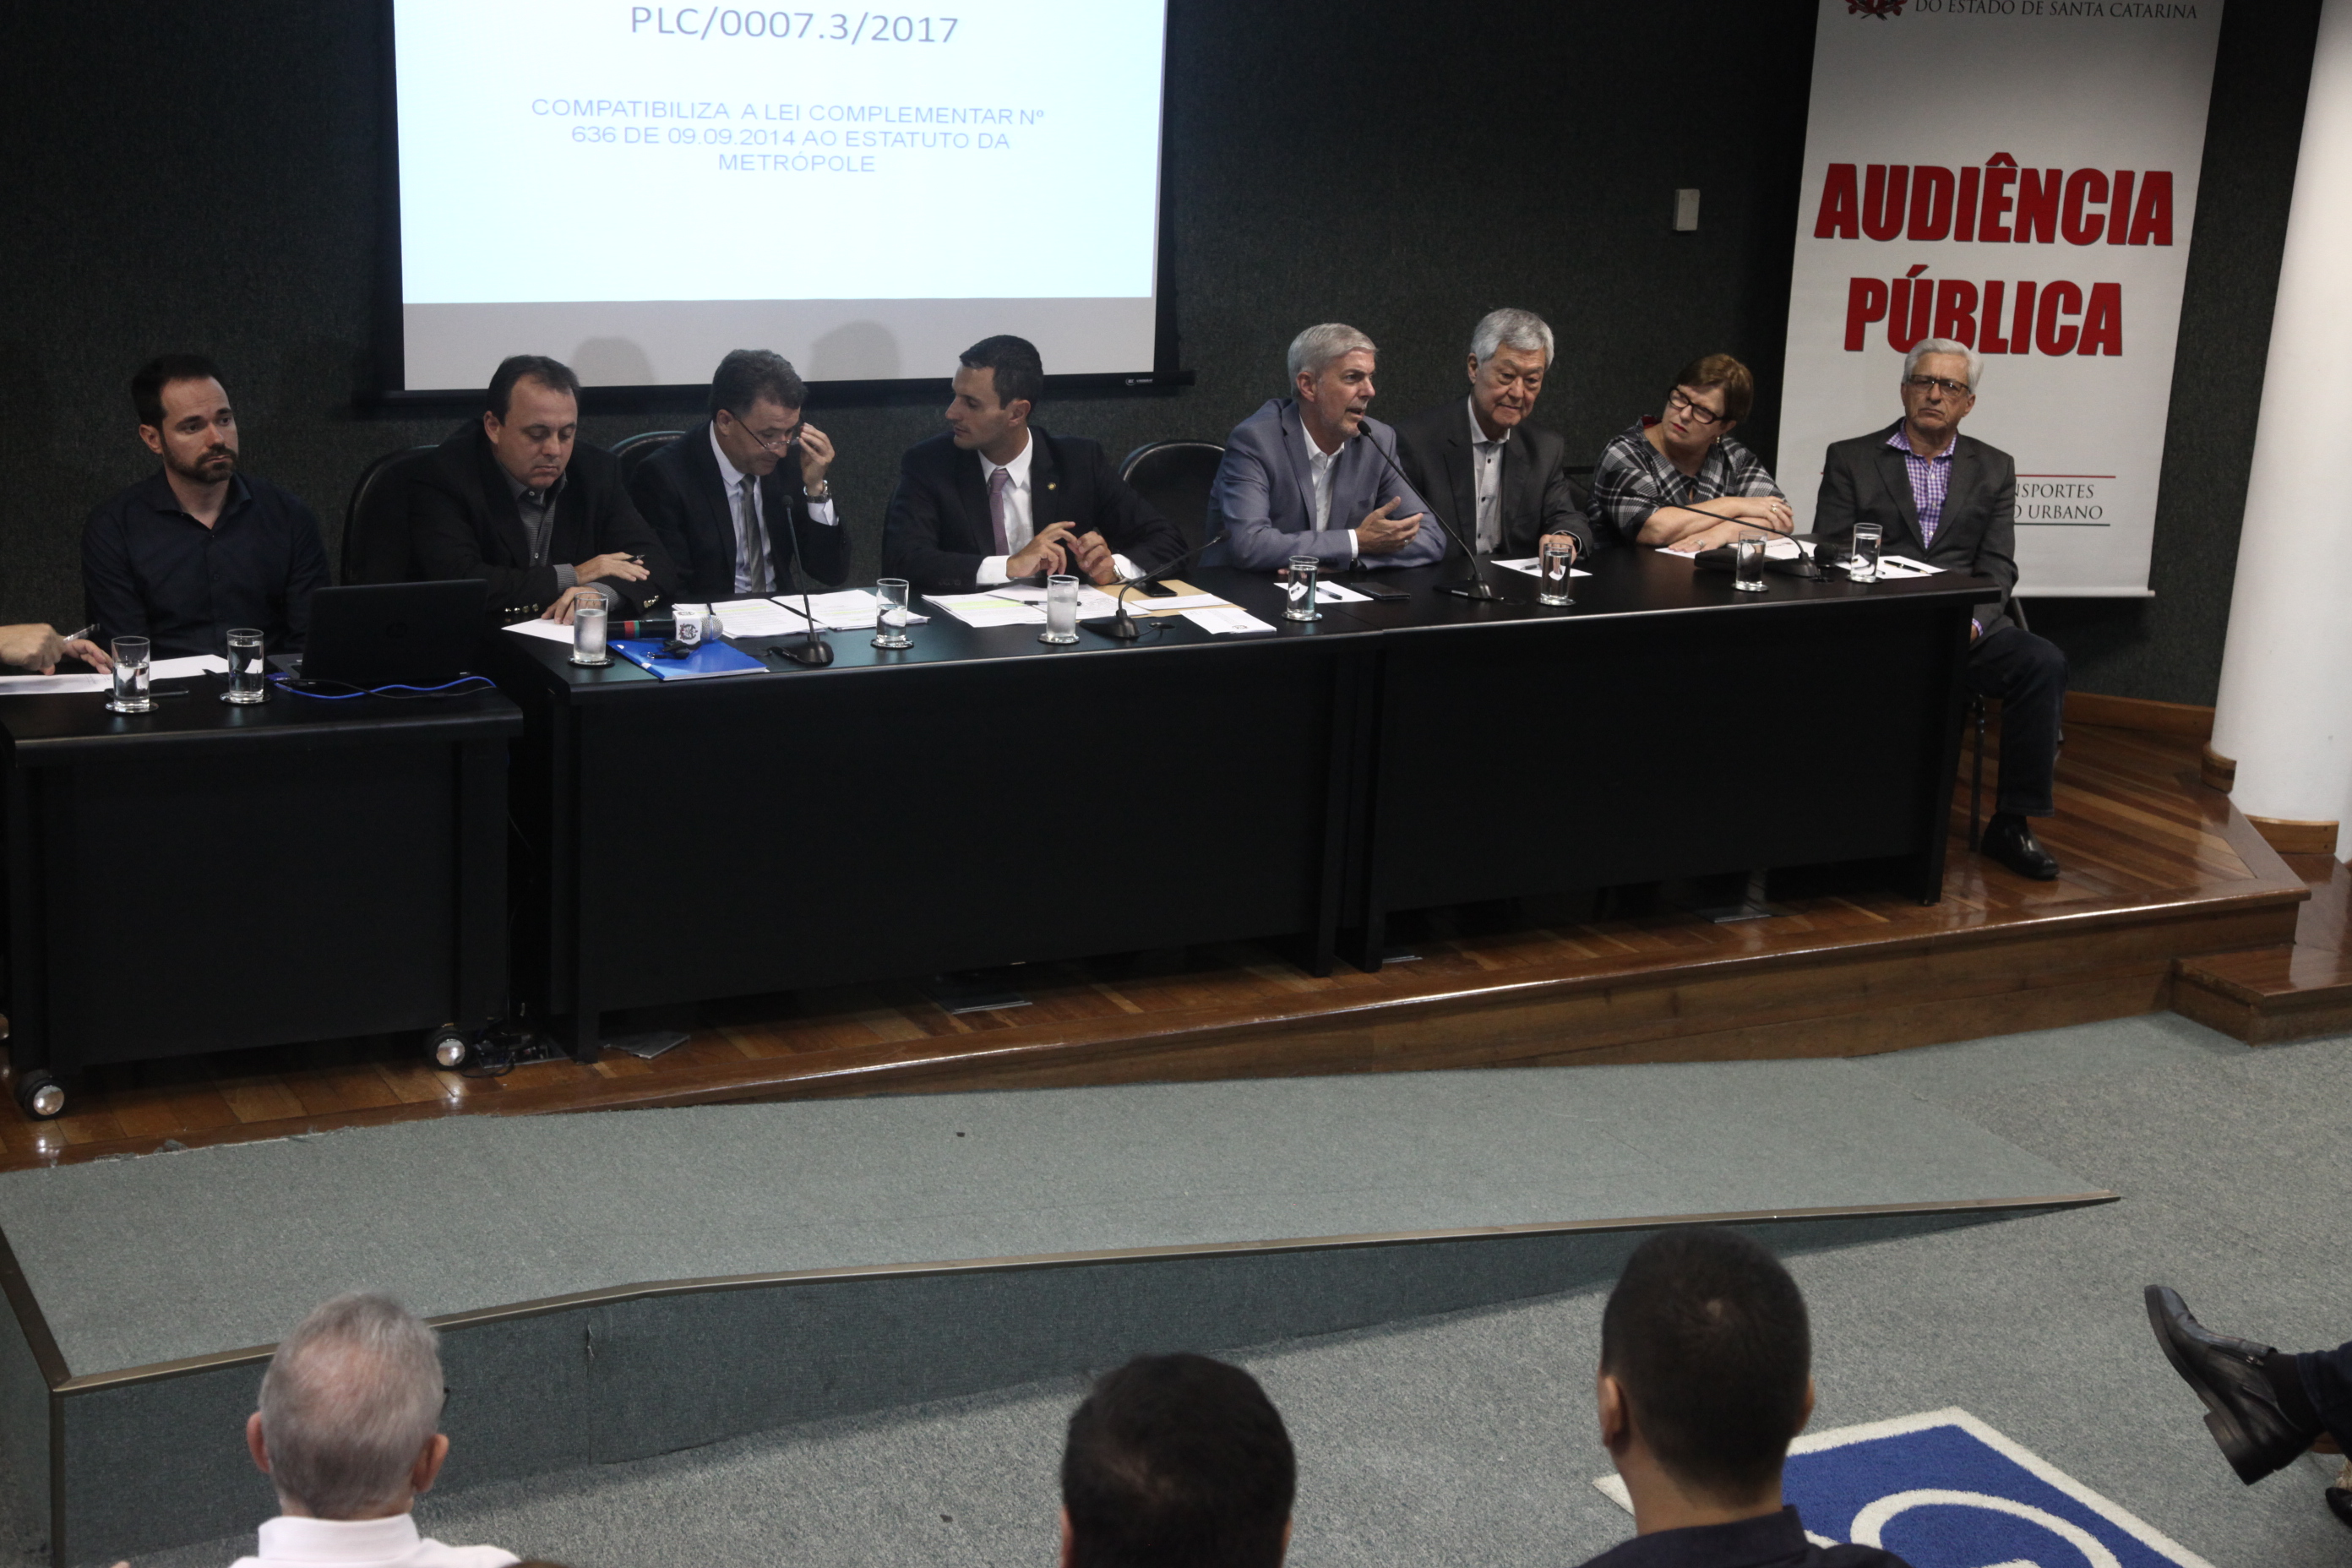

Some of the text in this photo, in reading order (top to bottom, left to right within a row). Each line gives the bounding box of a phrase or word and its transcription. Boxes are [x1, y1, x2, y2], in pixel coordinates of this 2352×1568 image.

[1914, 0, 1942, 13] DO
[1947, 0, 2015, 14] ESTADO
[2021, 0, 2044, 15] DE
[2049, 1, 2104, 17] SANTA
[2110, 3, 2197, 19] CATARINA
[631, 6, 958, 45] PLC/0007.3/2017
[531, 98, 730, 119] COMPATIBILIZA
[740, 103, 758, 120] A
[765, 103, 800, 121] LEI
[808, 104, 1013, 124] COMPLEMENTAR
[571, 126, 1010, 150] 636 DE 09.09.2014 AO ESTATUTO DA
[718, 151, 876, 172] METRÓPOLE
[1813, 151, 2174, 246] AUDIÊNCIA
[1843, 264, 2123, 357] PÚBLICA
[2028, 504, 2104, 520] URBANO
